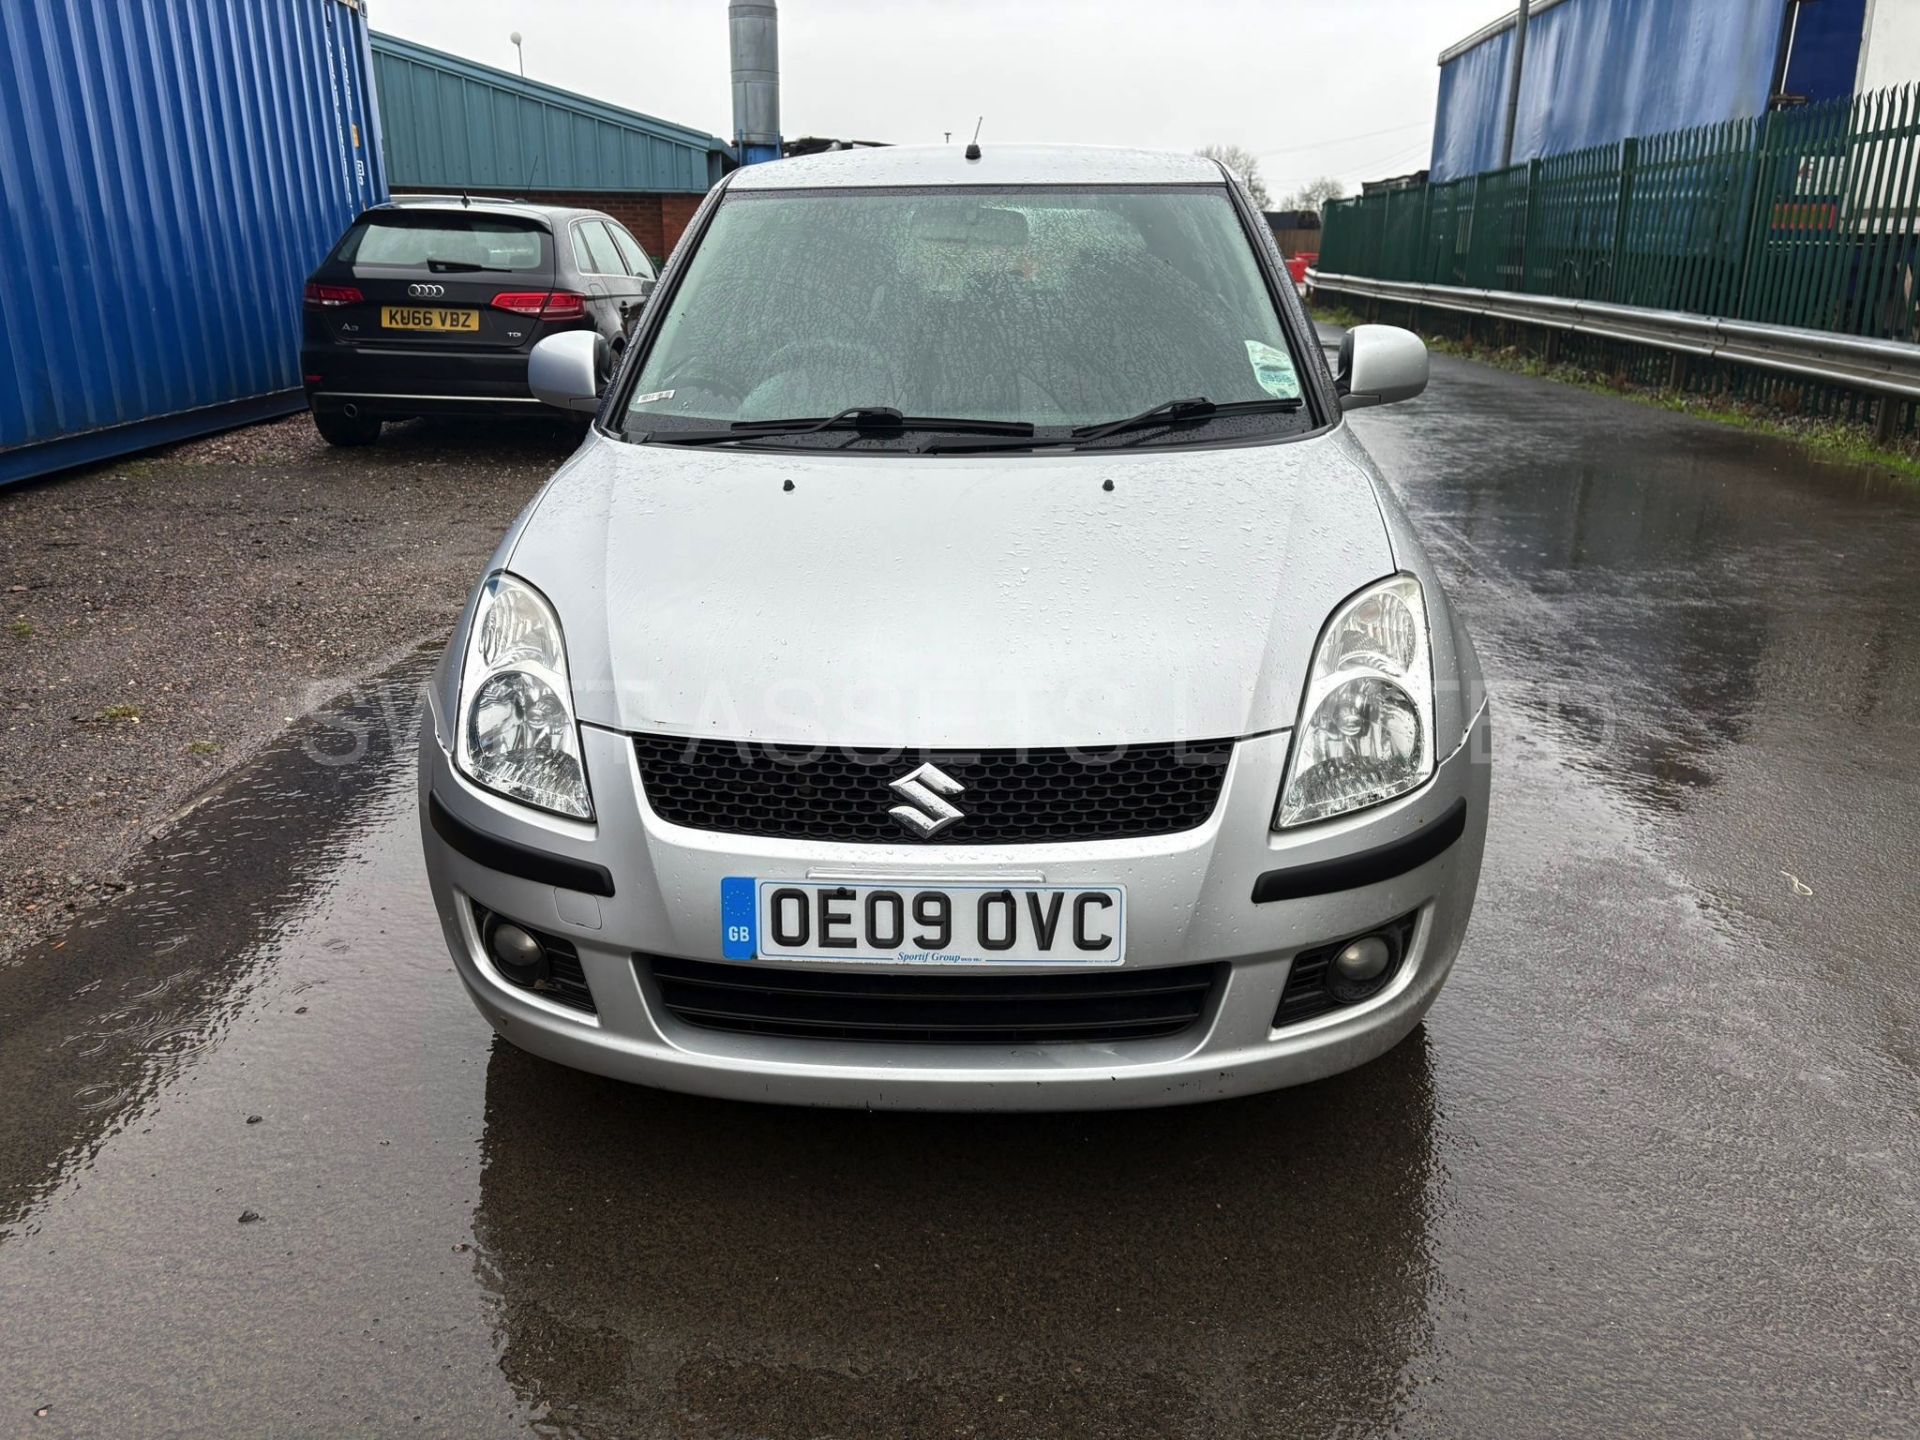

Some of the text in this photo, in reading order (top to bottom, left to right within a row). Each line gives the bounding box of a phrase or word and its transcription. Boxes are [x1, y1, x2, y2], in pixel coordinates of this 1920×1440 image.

[389, 310, 433, 326] KU66
[342, 323, 359, 331] A3
[770, 887, 1113, 951] OE09 OVC
[728, 926, 749, 942] GB
[897, 951, 930, 963] Sportif
[931, 952, 961, 963] Group
